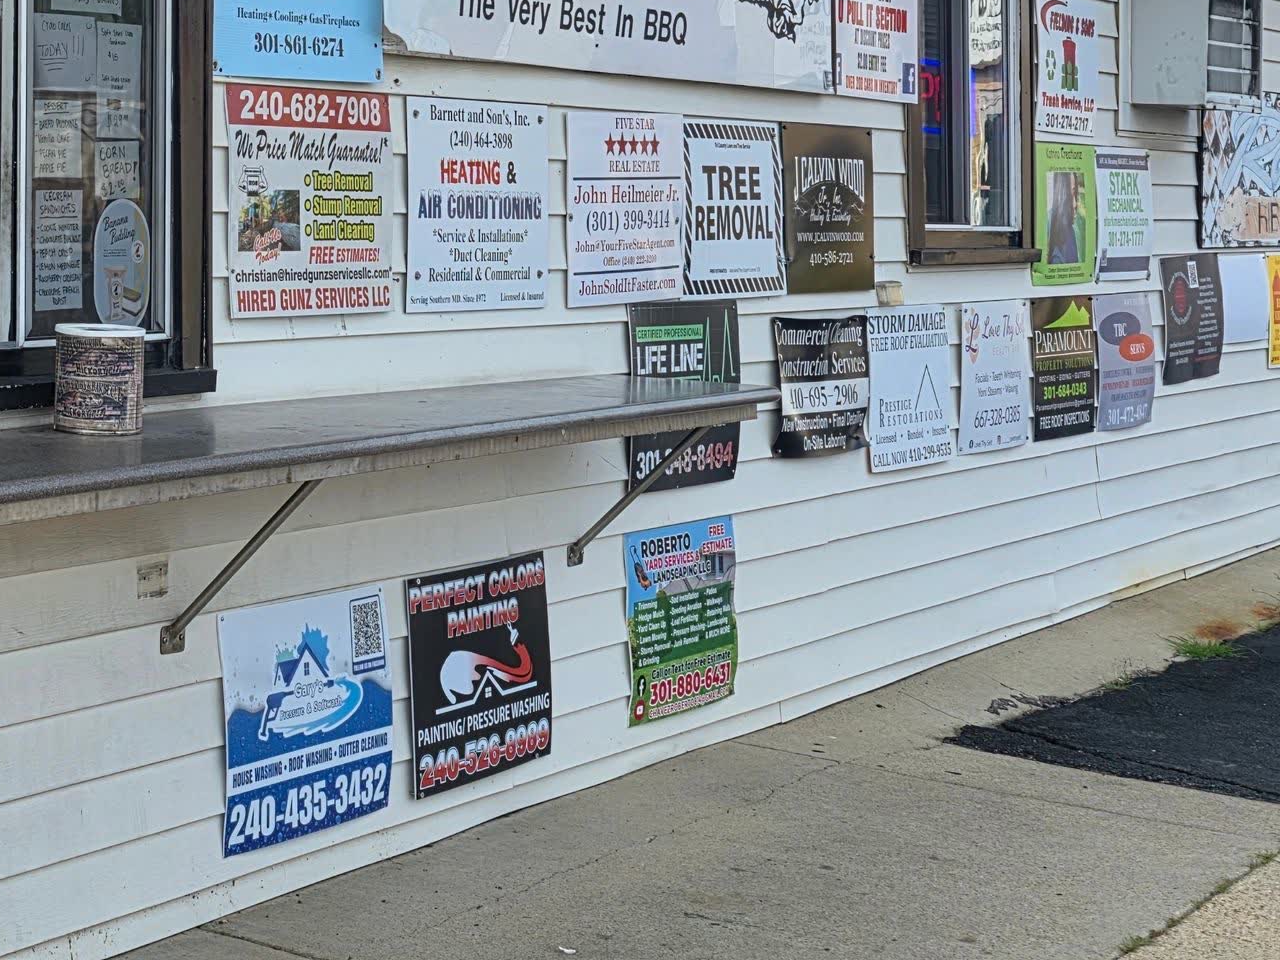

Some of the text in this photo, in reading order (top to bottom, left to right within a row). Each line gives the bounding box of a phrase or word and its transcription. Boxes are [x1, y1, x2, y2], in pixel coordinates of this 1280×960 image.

[616, 5, 633, 38] In
[643, 8, 687, 45] BBQ
[254, 32, 344, 57] 301-861-6274
[239, 90, 381, 126] 240-682-7908
[430, 104, 530, 127] Barnett and Son's, Inc.
[615, 117, 655, 130] FIVE STAR
[1045, 113, 1089, 131] 301-274-2717
[235, 130, 254, 159] We
[256, 130, 287, 161] Price
[288, 131, 325, 161] Match
[450, 131, 513, 150] (240) 464-3898
[440, 157, 517, 185] HEATING &
[609, 160, 660, 173] REAL ESTATE
[312, 171, 373, 191] Tree Removal
[702, 165, 761, 201] TREE
[1109, 171, 1139, 195] STARK
[313, 197, 382, 216] Stump Removal
[418, 190, 542, 220] AIR CONDITIONING
[573, 184, 679, 205] John Heilmeier Jr.
[313, 221, 375, 241] Land Clearing
[586, 208, 670, 235] (301) 399-3414
[695, 205, 773, 241] REMOVAL
[309, 246, 380, 264] FREE ESTIMATES!
[578, 277, 676, 297] JohnSoldItFaster.com
[237, 286, 390, 313] HIRED GUNZ SERVICES LLC
[868, 311, 947, 335] STORM DAMAGE!
[870, 331, 948, 352] FREE ROOF EVALUATION
[1035, 329, 1093, 353] PARAMOUNT
[635, 343, 703, 375] LIFE LINE
[790, 383, 859, 410] 410-695-2906
[1044, 382, 1087, 400] 301-684-0343
[873, 453, 890, 468] CALL
[892, 451, 908, 466] NOW
[709, 524, 724, 537] FREE
[641, 533, 732, 559] ROBERTO ESTIMATE
[645, 557, 663, 571] YARD
[664, 552, 694, 568] SERVICES
[652, 564, 698, 584] LANDSCAPING
[409, 558, 545, 615] PERFECT COLORS
[447, 597, 519, 639] PAINTING
[649, 662, 731, 706] 301-880-6431
[418, 693, 550, 748] PAINTING/ PRESSURE WASHING
[232, 733, 388, 788] HOUSE WASHING ROOF WASHING GUTTER CLEANING
[420, 718, 549, 789] 240-526-8989
[228, 762, 387, 848] 240-435-3432
